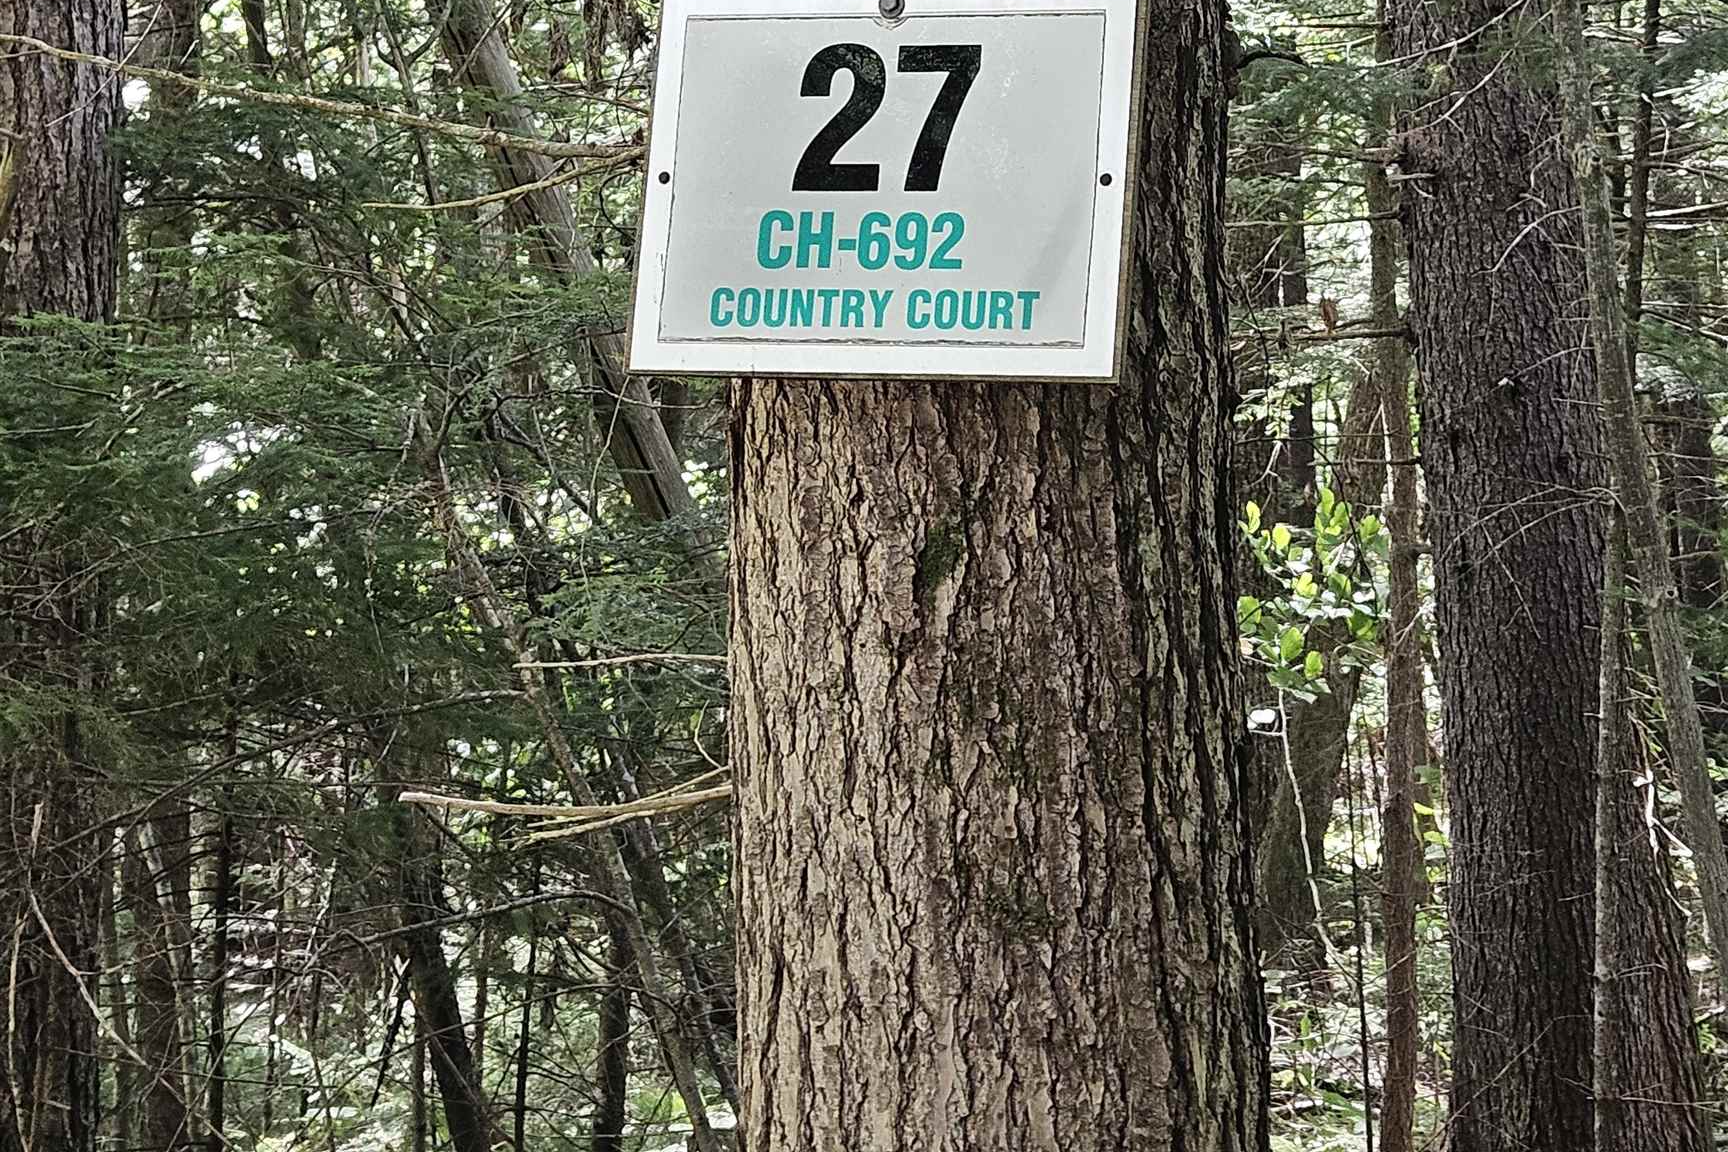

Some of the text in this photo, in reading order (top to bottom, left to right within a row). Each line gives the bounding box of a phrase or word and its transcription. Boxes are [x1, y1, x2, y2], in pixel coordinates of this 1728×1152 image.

[791, 43, 982, 192] 27
[757, 209, 965, 271] CH-692
[710, 287, 1041, 331] COUNTRY COURT
